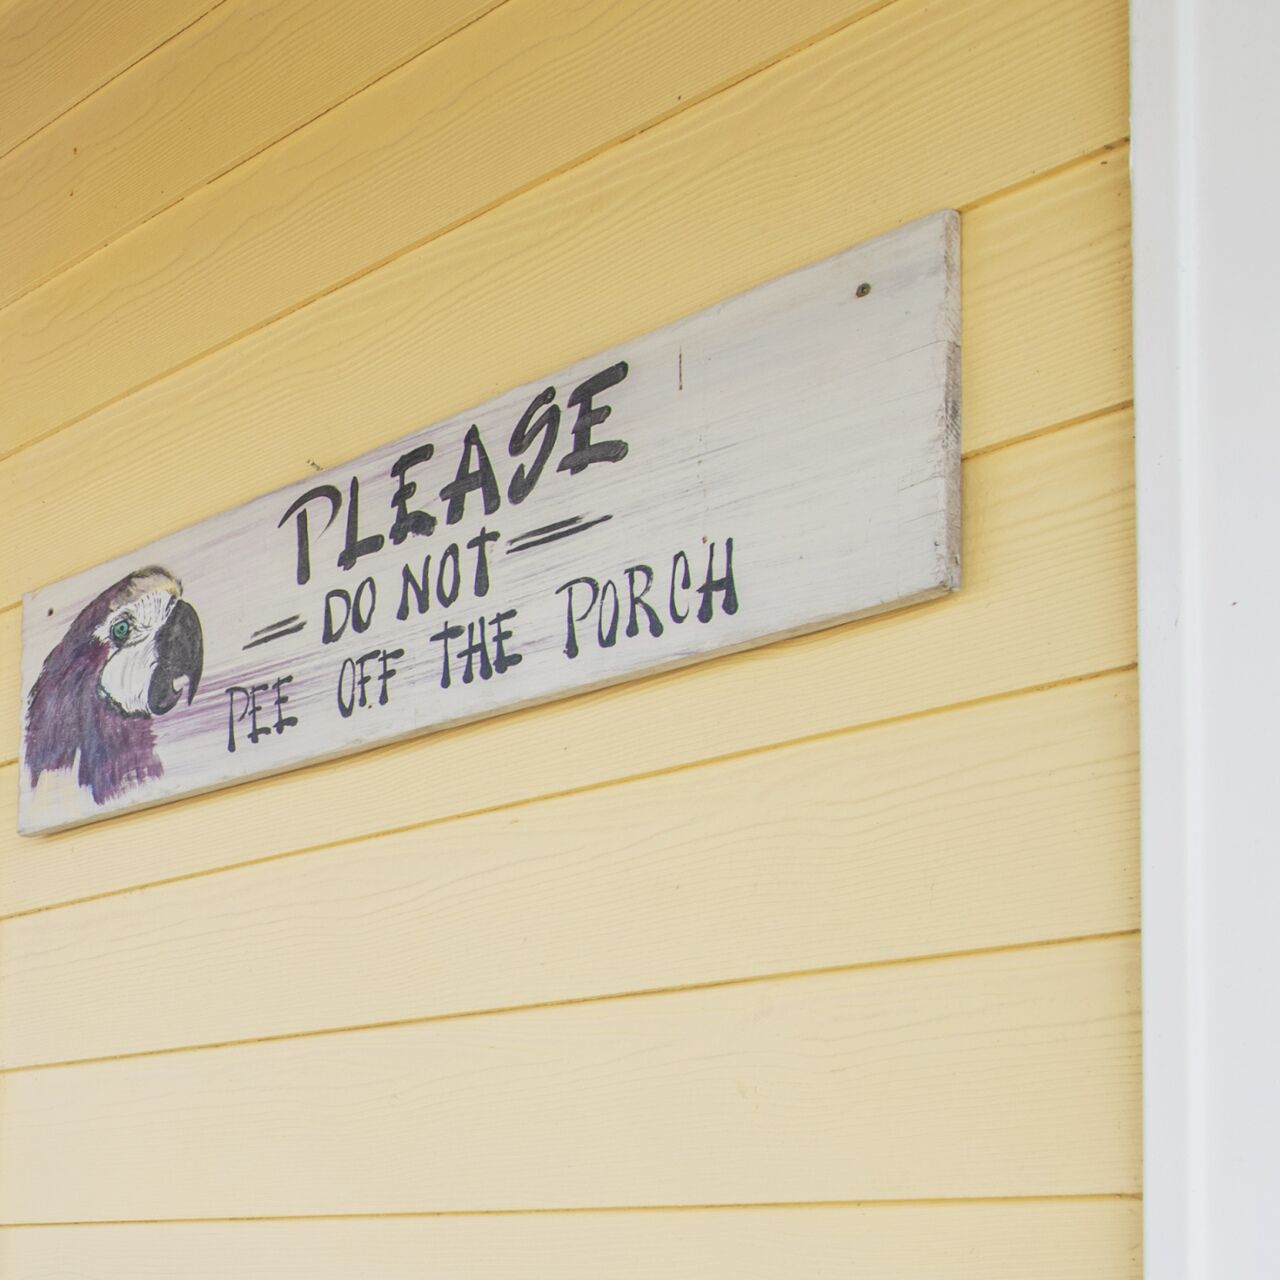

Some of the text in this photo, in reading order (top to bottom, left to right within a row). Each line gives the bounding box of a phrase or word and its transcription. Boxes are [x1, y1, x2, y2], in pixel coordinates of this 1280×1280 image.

[279, 361, 629, 585] PLEASE
[226, 537, 738, 752] PEE OFF THE PORCH
[323, 526, 500, 645] DO NOT
